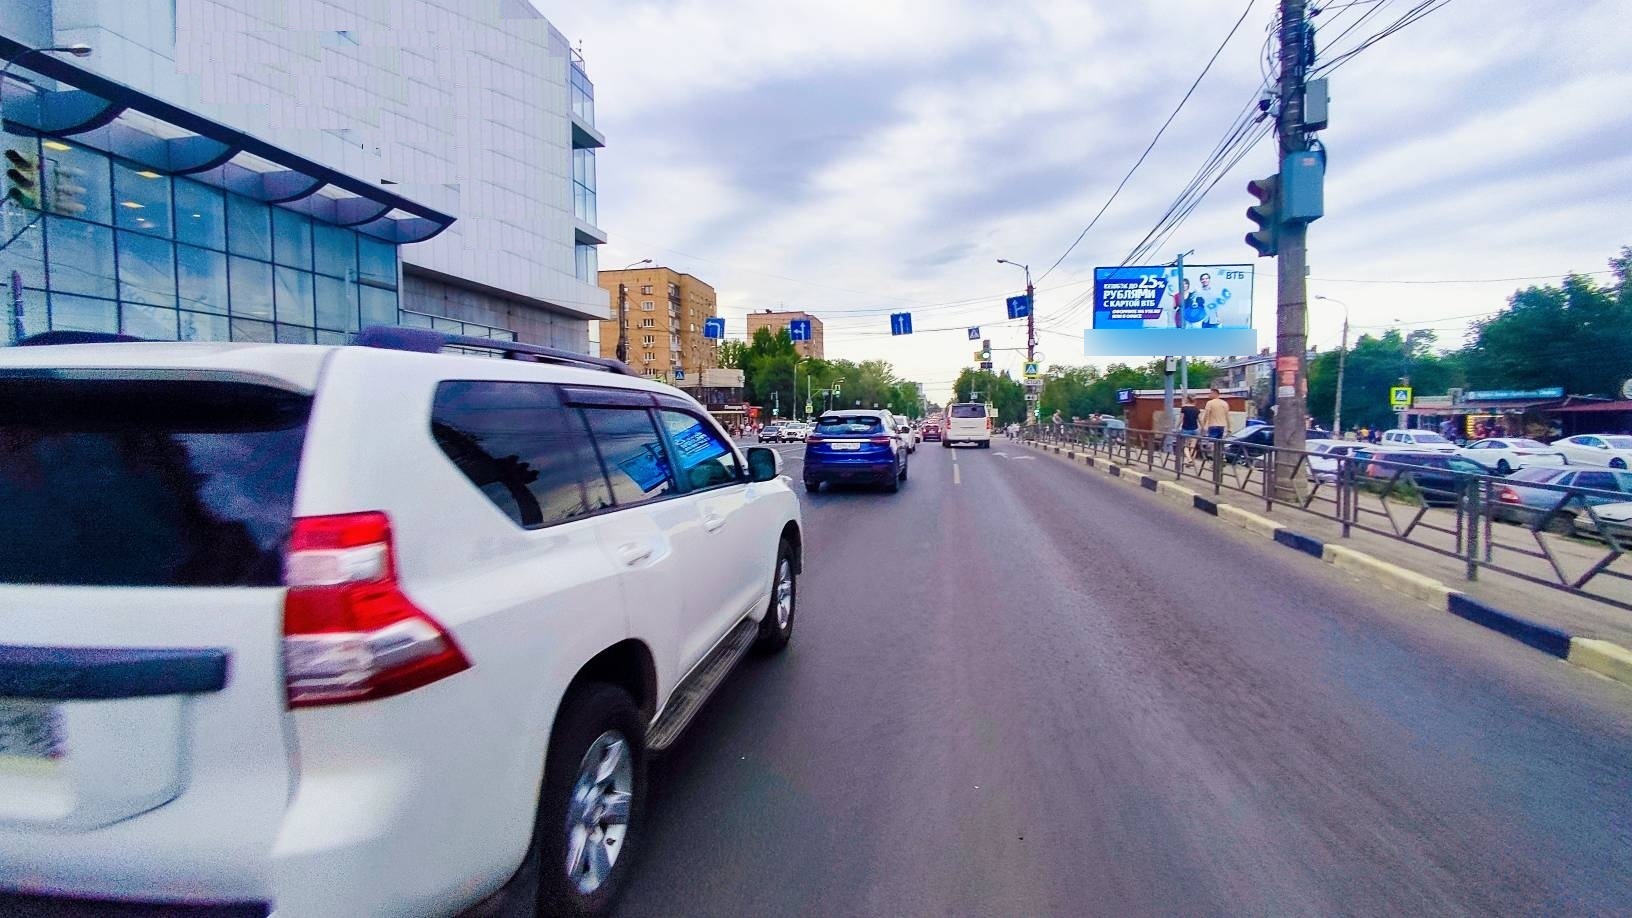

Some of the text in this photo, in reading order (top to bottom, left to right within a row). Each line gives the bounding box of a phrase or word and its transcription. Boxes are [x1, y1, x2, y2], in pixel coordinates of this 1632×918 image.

[1226, 271, 1244, 280] ВТБ
[1139, 274, 1165, 289] 25%
[1103, 289, 1156, 299] РУБЛЯМИ
[1110, 299, 1140, 307] КАРТОЙ
[1141, 299, 1156, 307] ВТБ
